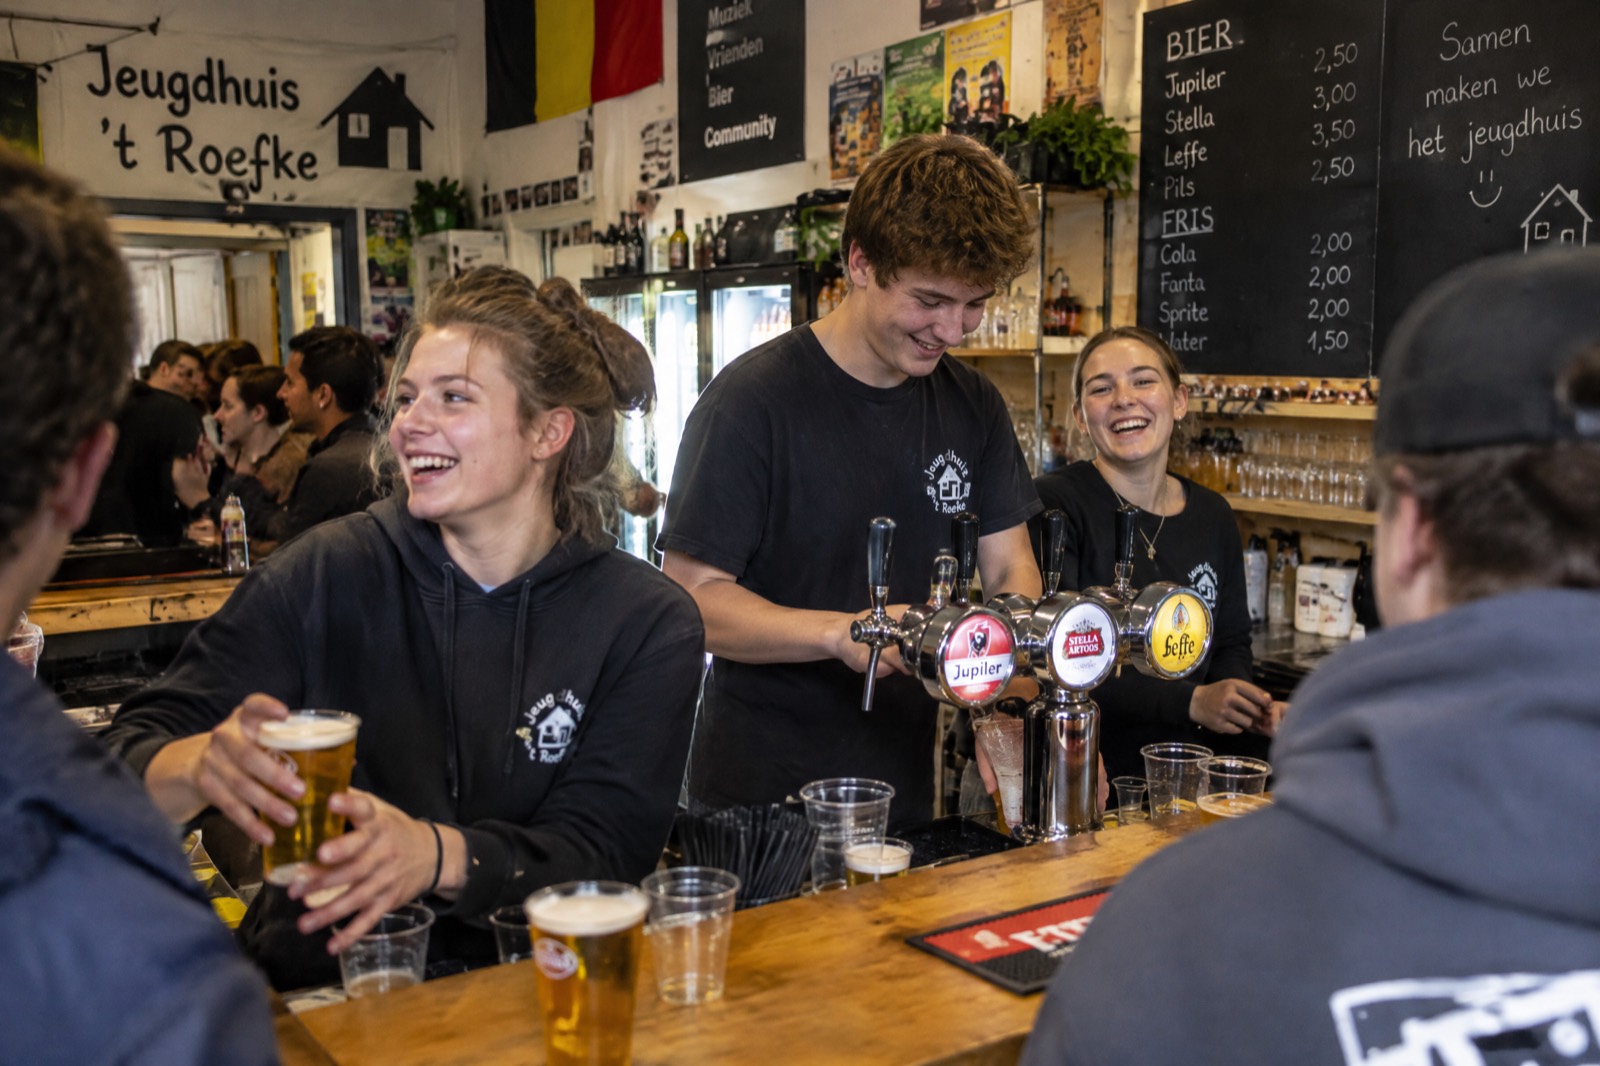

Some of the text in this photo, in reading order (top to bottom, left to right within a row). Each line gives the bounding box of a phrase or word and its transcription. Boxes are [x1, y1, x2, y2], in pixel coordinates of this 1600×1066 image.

[707, 0, 754, 30] Muziek
[706, 36, 764, 70] Vrienden
[1166, 19, 1233, 62] BIER
[1440, 21, 1531, 61] Samen
[87, 44, 301, 117] Jeugdhuis
[1165, 42, 1358, 102] Jupiler 2,50
[1426, 66, 1551, 108] maken we
[708, 84, 734, 108] Bier
[1165, 82, 1356, 134] Stella 3,00
[704, 114, 777, 149] Community
[1164, 119, 1355, 169] Leffe 3,50
[1408, 105, 1583, 164] het jeugdhuis
[101, 118, 318, 193] 't Roefke
[1164, 156, 1355, 200] Pils 2,50
[1162, 206, 1214, 238] FRIS
[1161, 232, 1352, 265] Cola 2,00
[1160, 265, 1351, 294] Fanta 2,00
[1159, 298, 1350, 329] Sprite 2,00
[1307, 330, 1349, 355] 1,50
[1068, 634, 1098, 646] STELLA
[954, 661, 1002, 680] Jupiler
